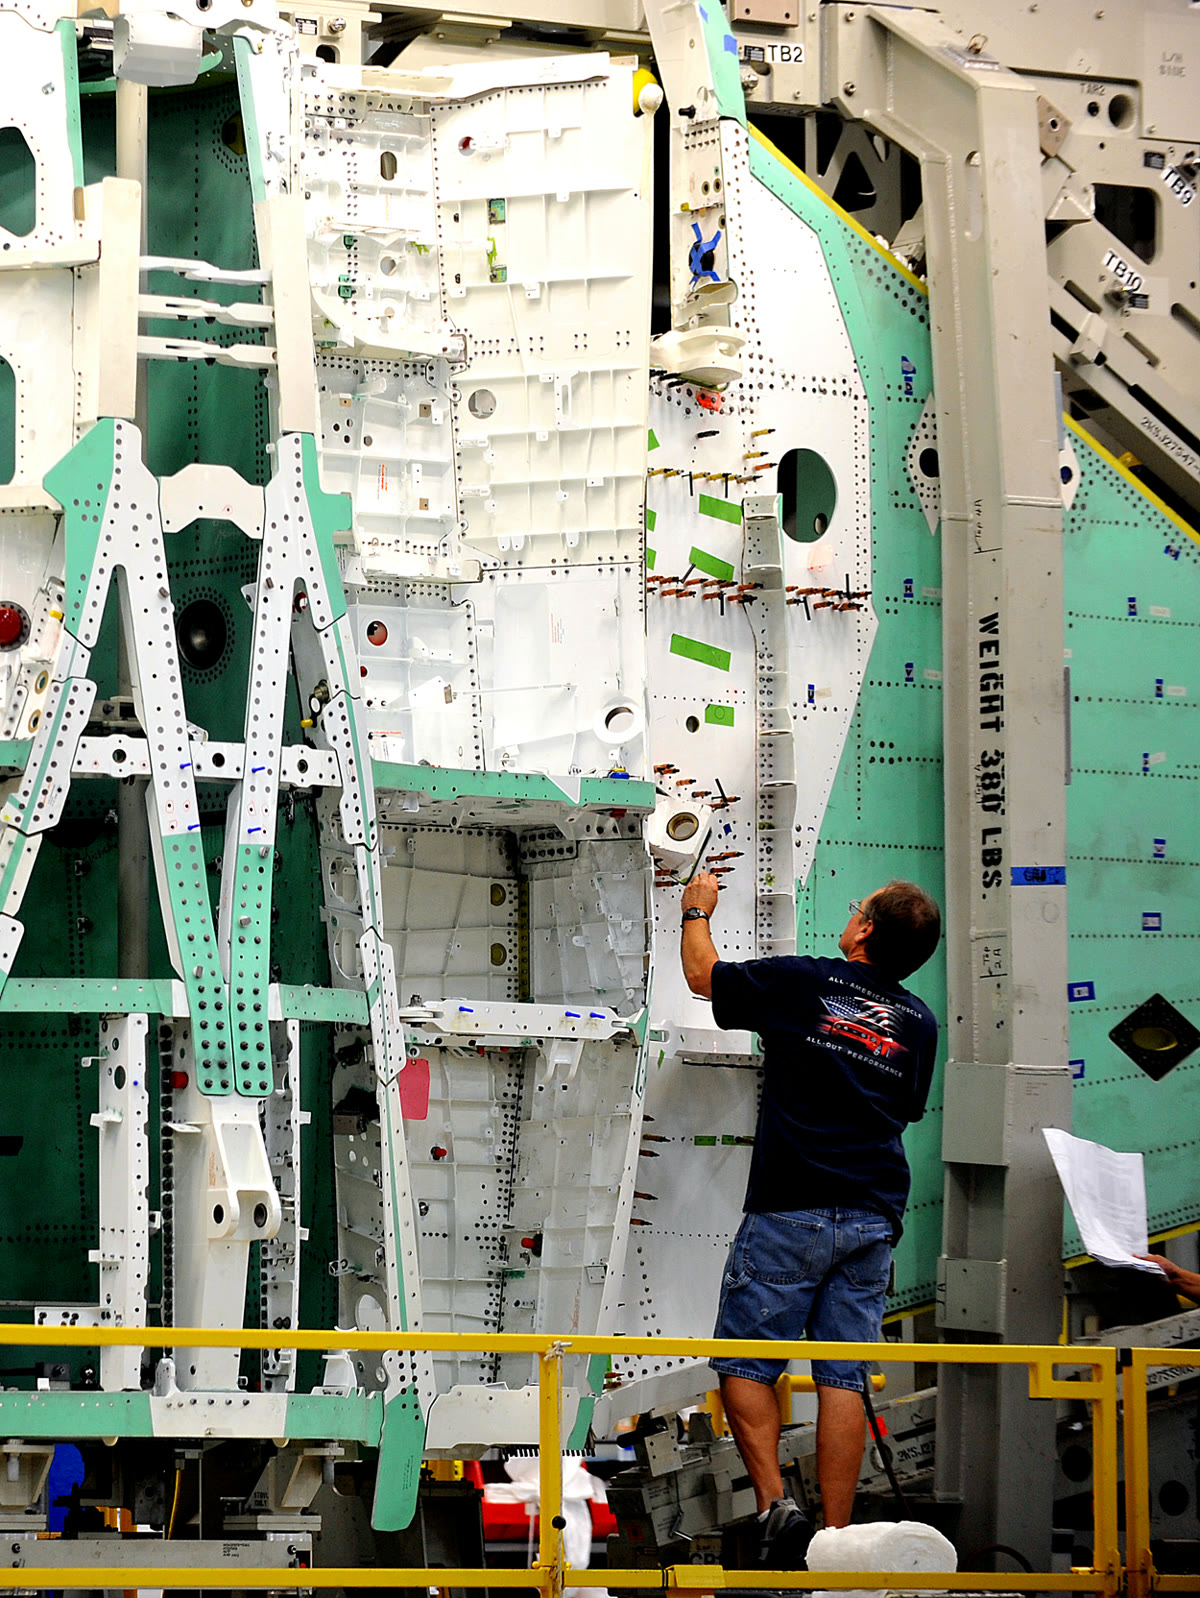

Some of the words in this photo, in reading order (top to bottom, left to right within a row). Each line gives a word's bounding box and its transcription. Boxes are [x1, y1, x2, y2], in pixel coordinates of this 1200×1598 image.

[767, 44, 803, 63] TB2
[1163, 168, 1194, 206] TB9
[1104, 250, 1143, 293] TB10
[979, 611, 1002, 733] WEIGHT
[980, 748, 1004, 815] 380
[981, 827, 1003, 900] LBS.
[828, 976, 891, 1005] ALL-AMERICAN
[894, 1001, 923, 1020] MUSCLE
[805, 1036, 843, 1053] ALL-OUT
[847, 1050, 903, 1078] PERFORMANCE
